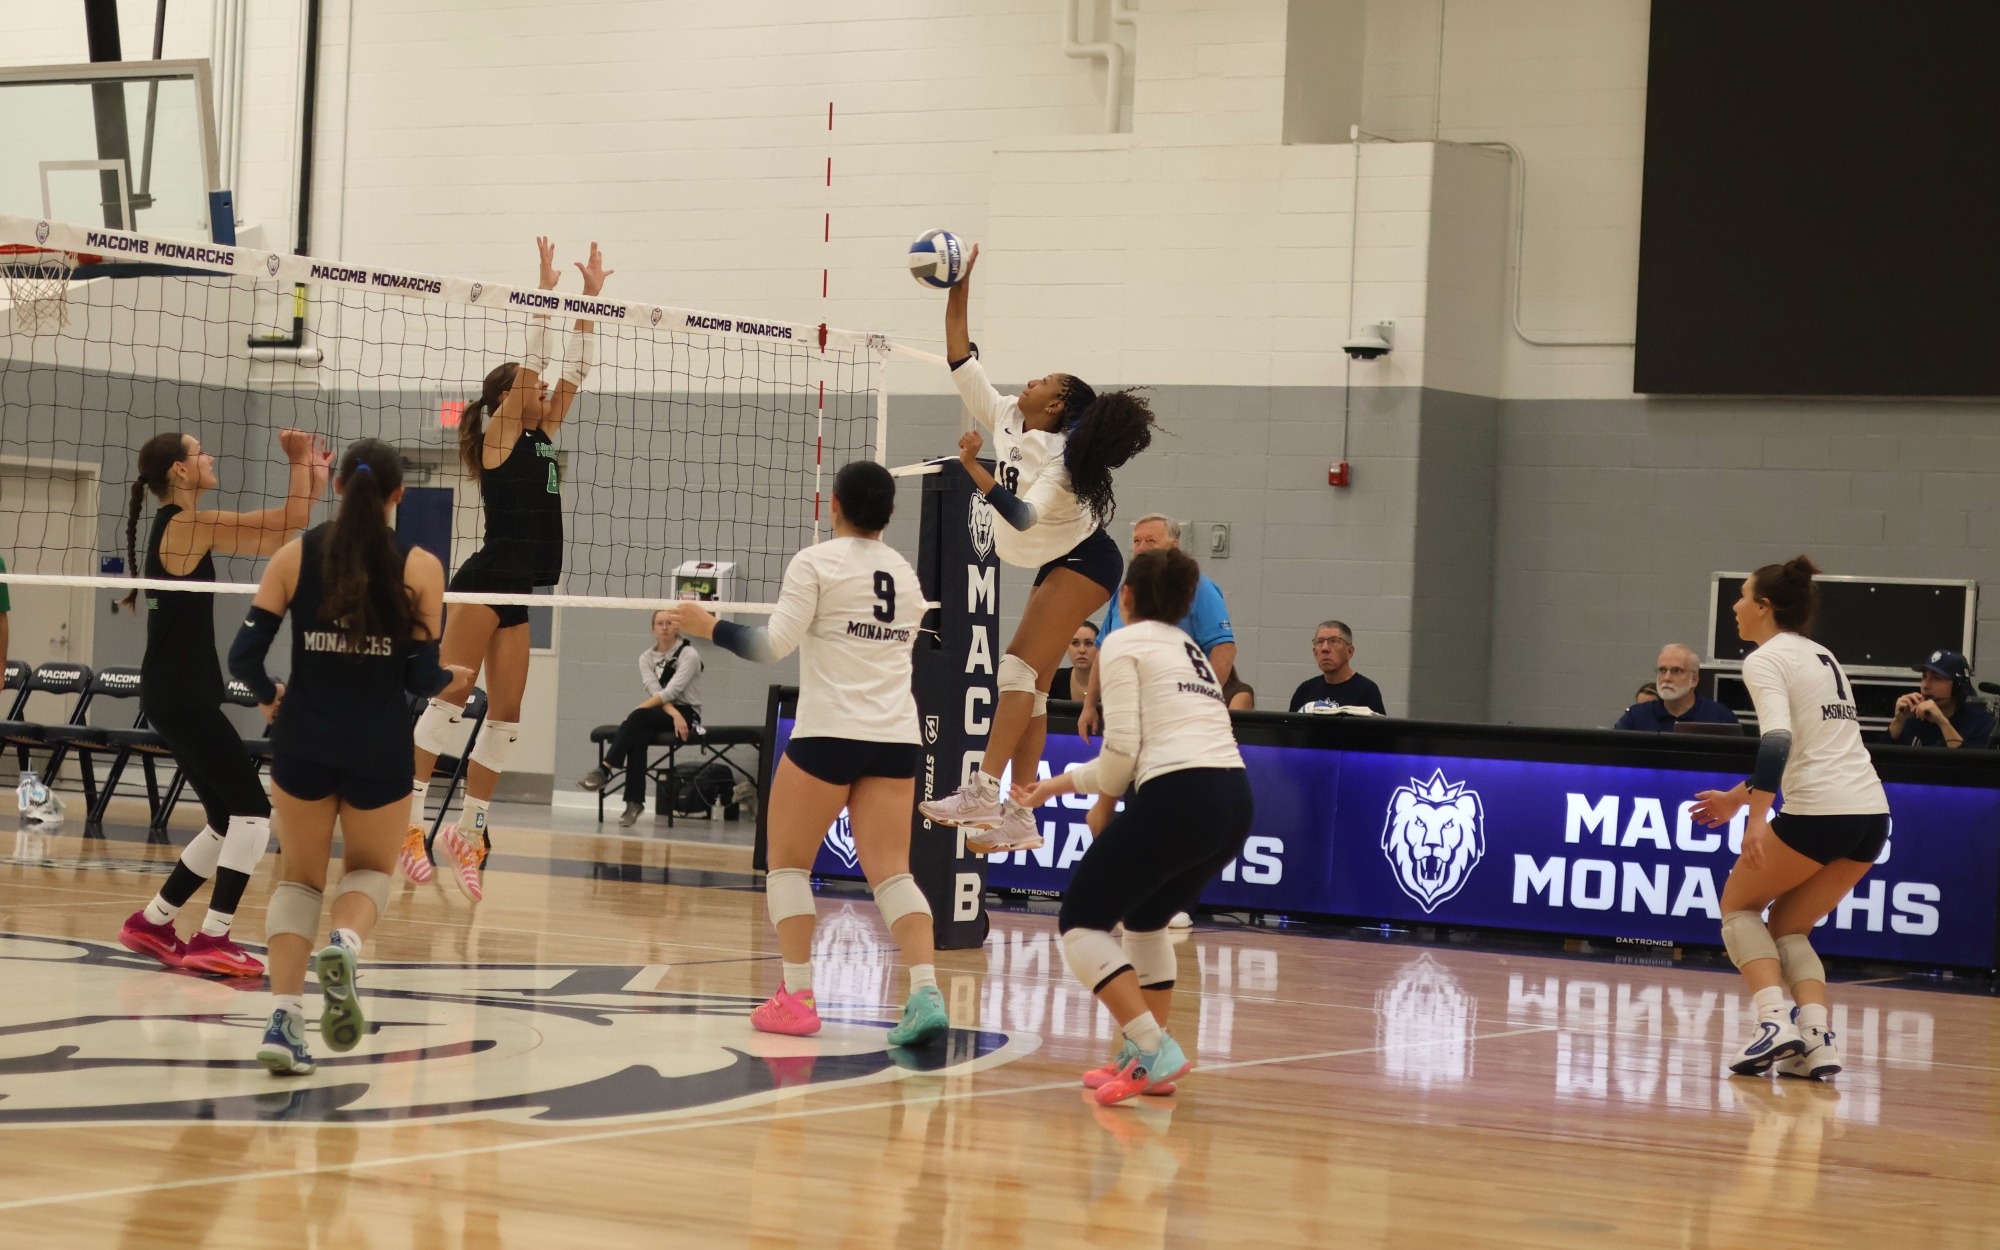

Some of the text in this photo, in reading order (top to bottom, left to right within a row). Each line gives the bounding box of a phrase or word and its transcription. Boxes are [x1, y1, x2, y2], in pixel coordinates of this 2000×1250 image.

[86, 232, 235, 266] MACOMB MONARCHS
[310, 265, 442, 294] MACOMB MONARCHS
[509, 292, 626, 319] MACOMB MONARCHS
[686, 315, 792, 339] MACOMB MONARCHS
[999, 461, 1020, 495] 18
[873, 570, 896, 624] 9
[38, 669, 80, 680] MACOMB
[1816, 653, 1848, 701] 7
[923, 755, 935, 831] STERLG
[1010, 887, 1060, 897] DAKTRONICS
[1512, 853, 1941, 937] MONAHS
[1616, 937, 1674, 947] DAKTRONICS
